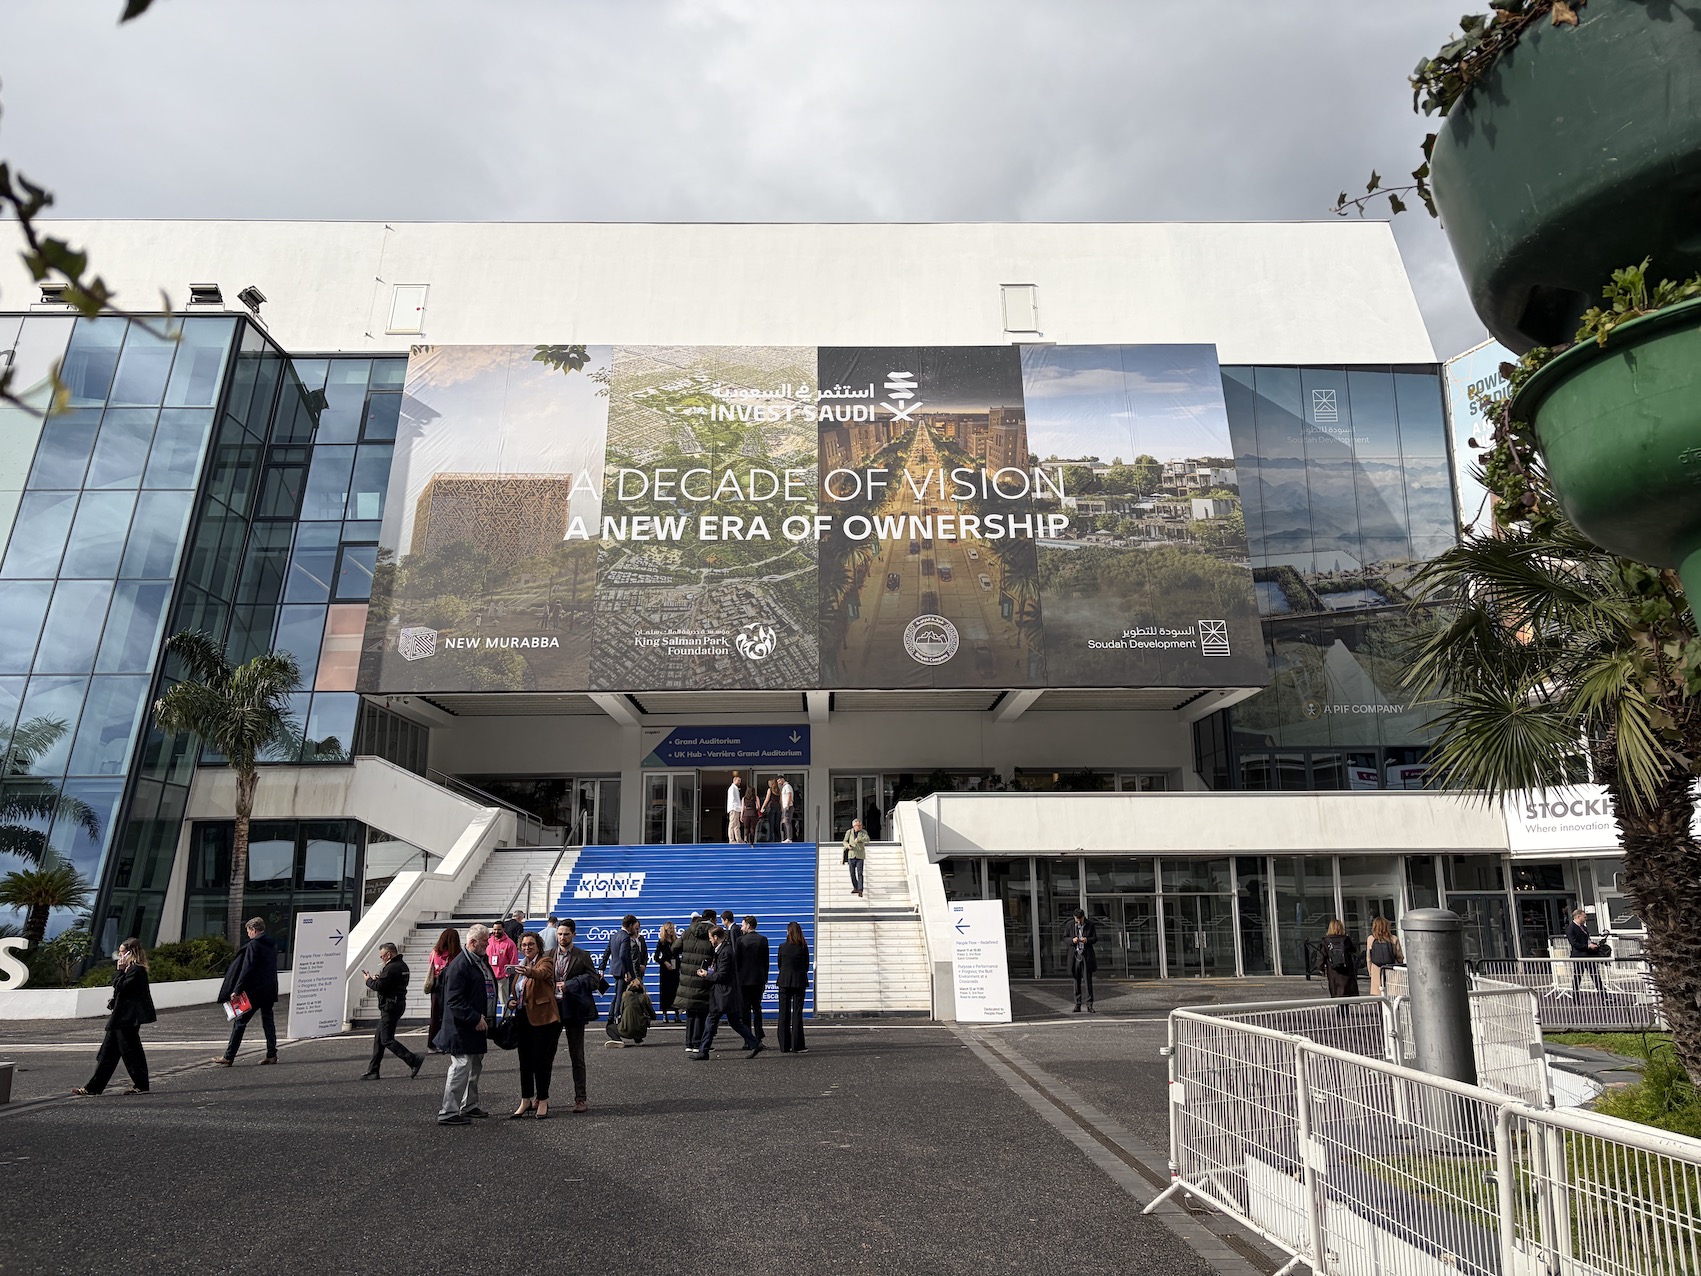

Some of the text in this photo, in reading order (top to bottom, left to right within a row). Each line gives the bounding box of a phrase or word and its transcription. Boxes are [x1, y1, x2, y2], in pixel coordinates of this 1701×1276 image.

[710, 404, 875, 422] INVEST SAUDI
[567, 466, 1066, 502] A DECADE OF VISION
[563, 513, 1071, 542] A NEW ERA OF OWNERSHIP
[1159, 626, 1195, 639] السودة
[445, 636, 560, 650] NEW MURABBA
[634, 636, 731, 647] King Salman Park
[1087, 639, 1197, 650] Soudah Development
[667, 646, 729, 656] Foundation
[1323, 704, 1405, 714] A PIF COMPANY
[699, 737, 741, 745] Auditorium
[674, 751, 686, 759] UK
[737, 750, 760, 758] Grand
[761, 749, 803, 757] Auditorium
[1526, 798, 1616, 820] STOCKH
[1525, 821, 1610, 833] Where innovation
[577, 877, 643, 893] KONE
[586, 926, 655, 941] Coner
